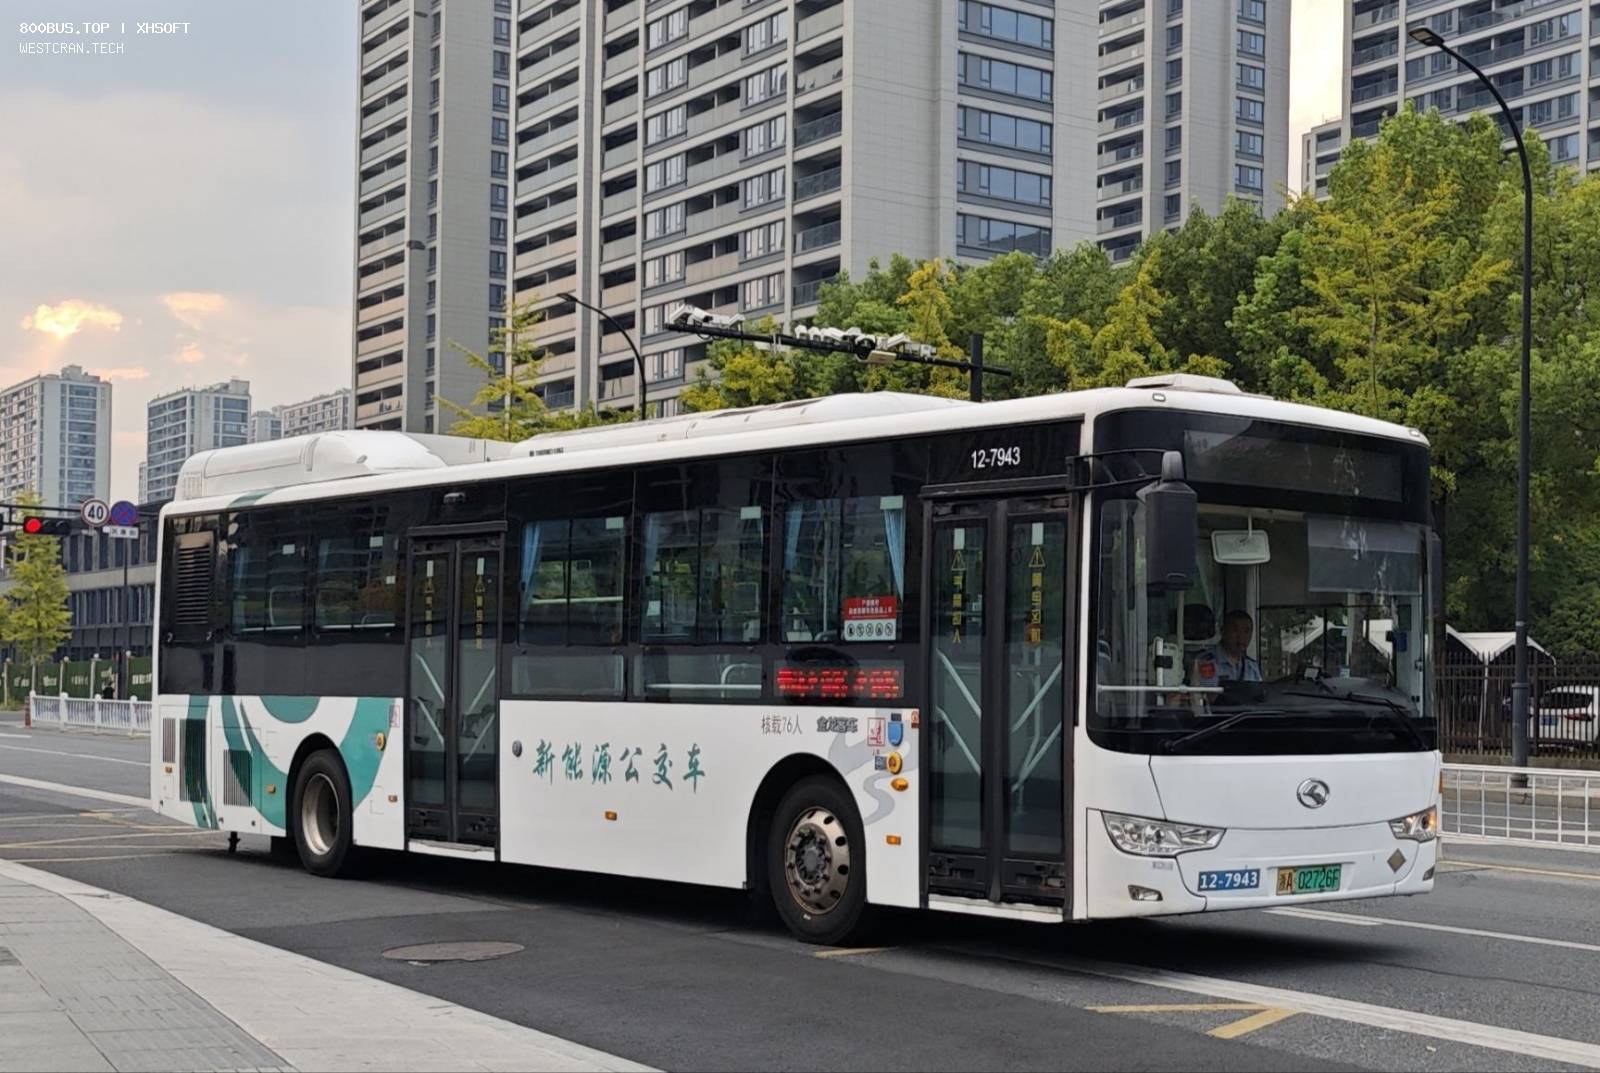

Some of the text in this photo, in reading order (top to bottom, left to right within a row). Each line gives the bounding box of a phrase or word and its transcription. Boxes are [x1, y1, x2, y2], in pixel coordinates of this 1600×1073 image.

[971, 446, 1020, 469] 12-7943
[88, 504, 104, 520] 40
[761, 713, 803, 735] 核载76人
[532, 739, 706, 795] 新能源公交车
[1200, 871, 1259, 889] 12-7943
[1298, 868, 1340, 890] 02726F
